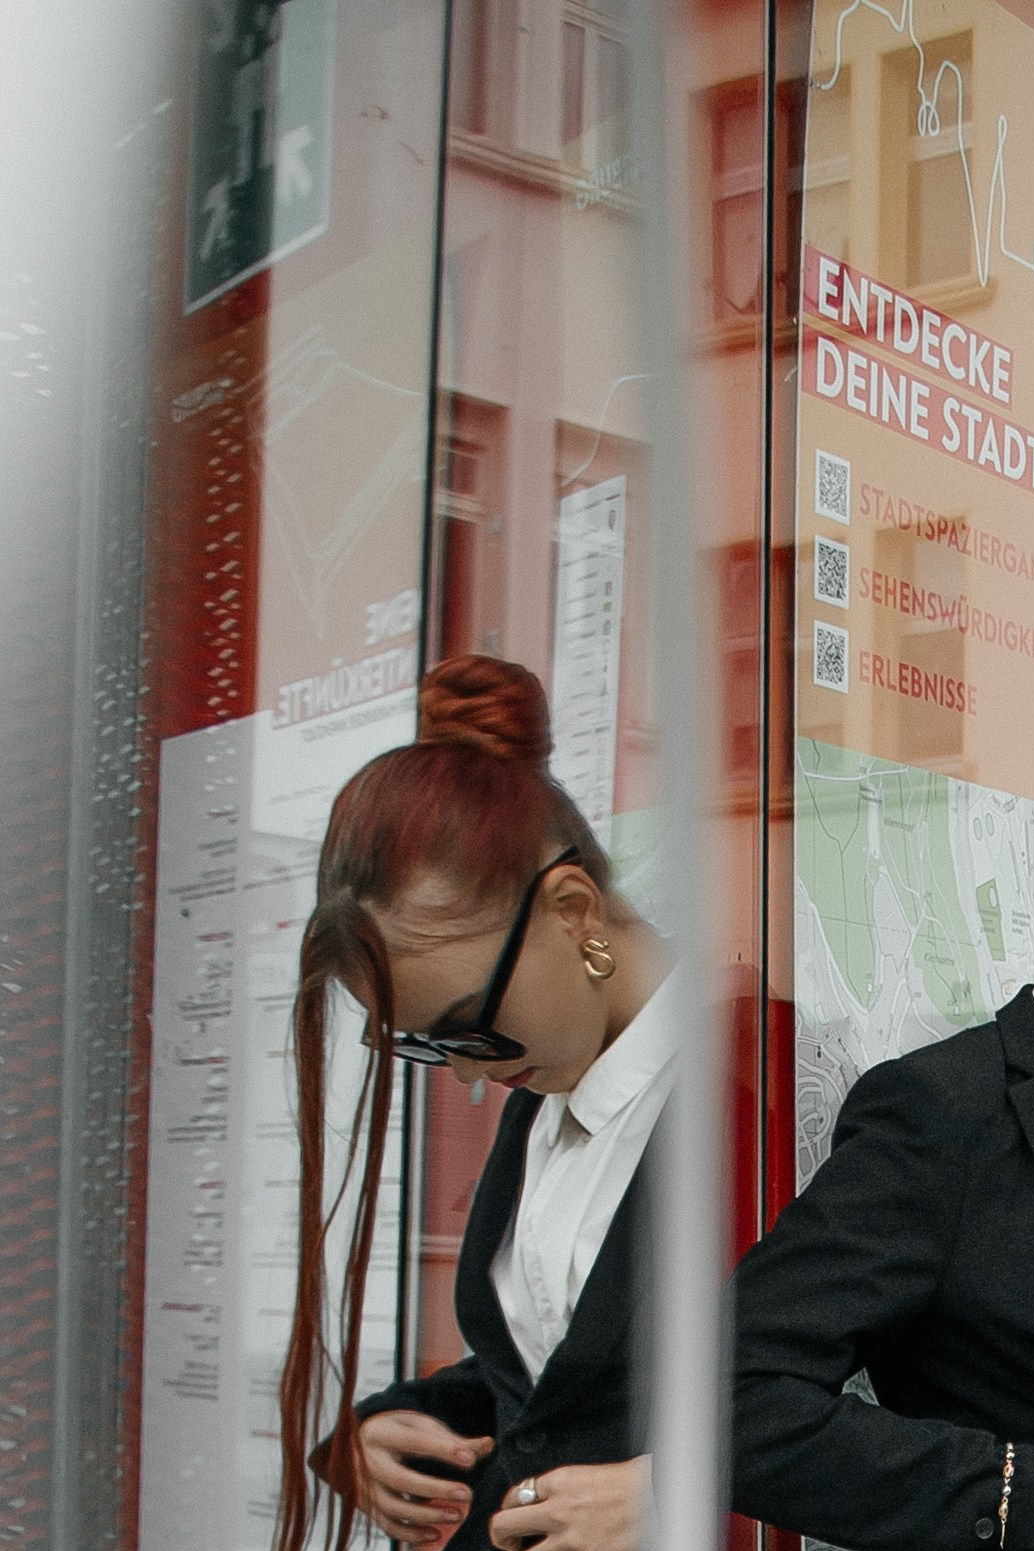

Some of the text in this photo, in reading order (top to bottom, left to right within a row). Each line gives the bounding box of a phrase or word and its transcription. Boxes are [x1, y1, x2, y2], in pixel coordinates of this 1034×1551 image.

[818, 256, 1011, 404] ENTDECKE
[816, 337, 929, 441] DEINE
[859, 650, 978, 717] ERLEBNISSE
